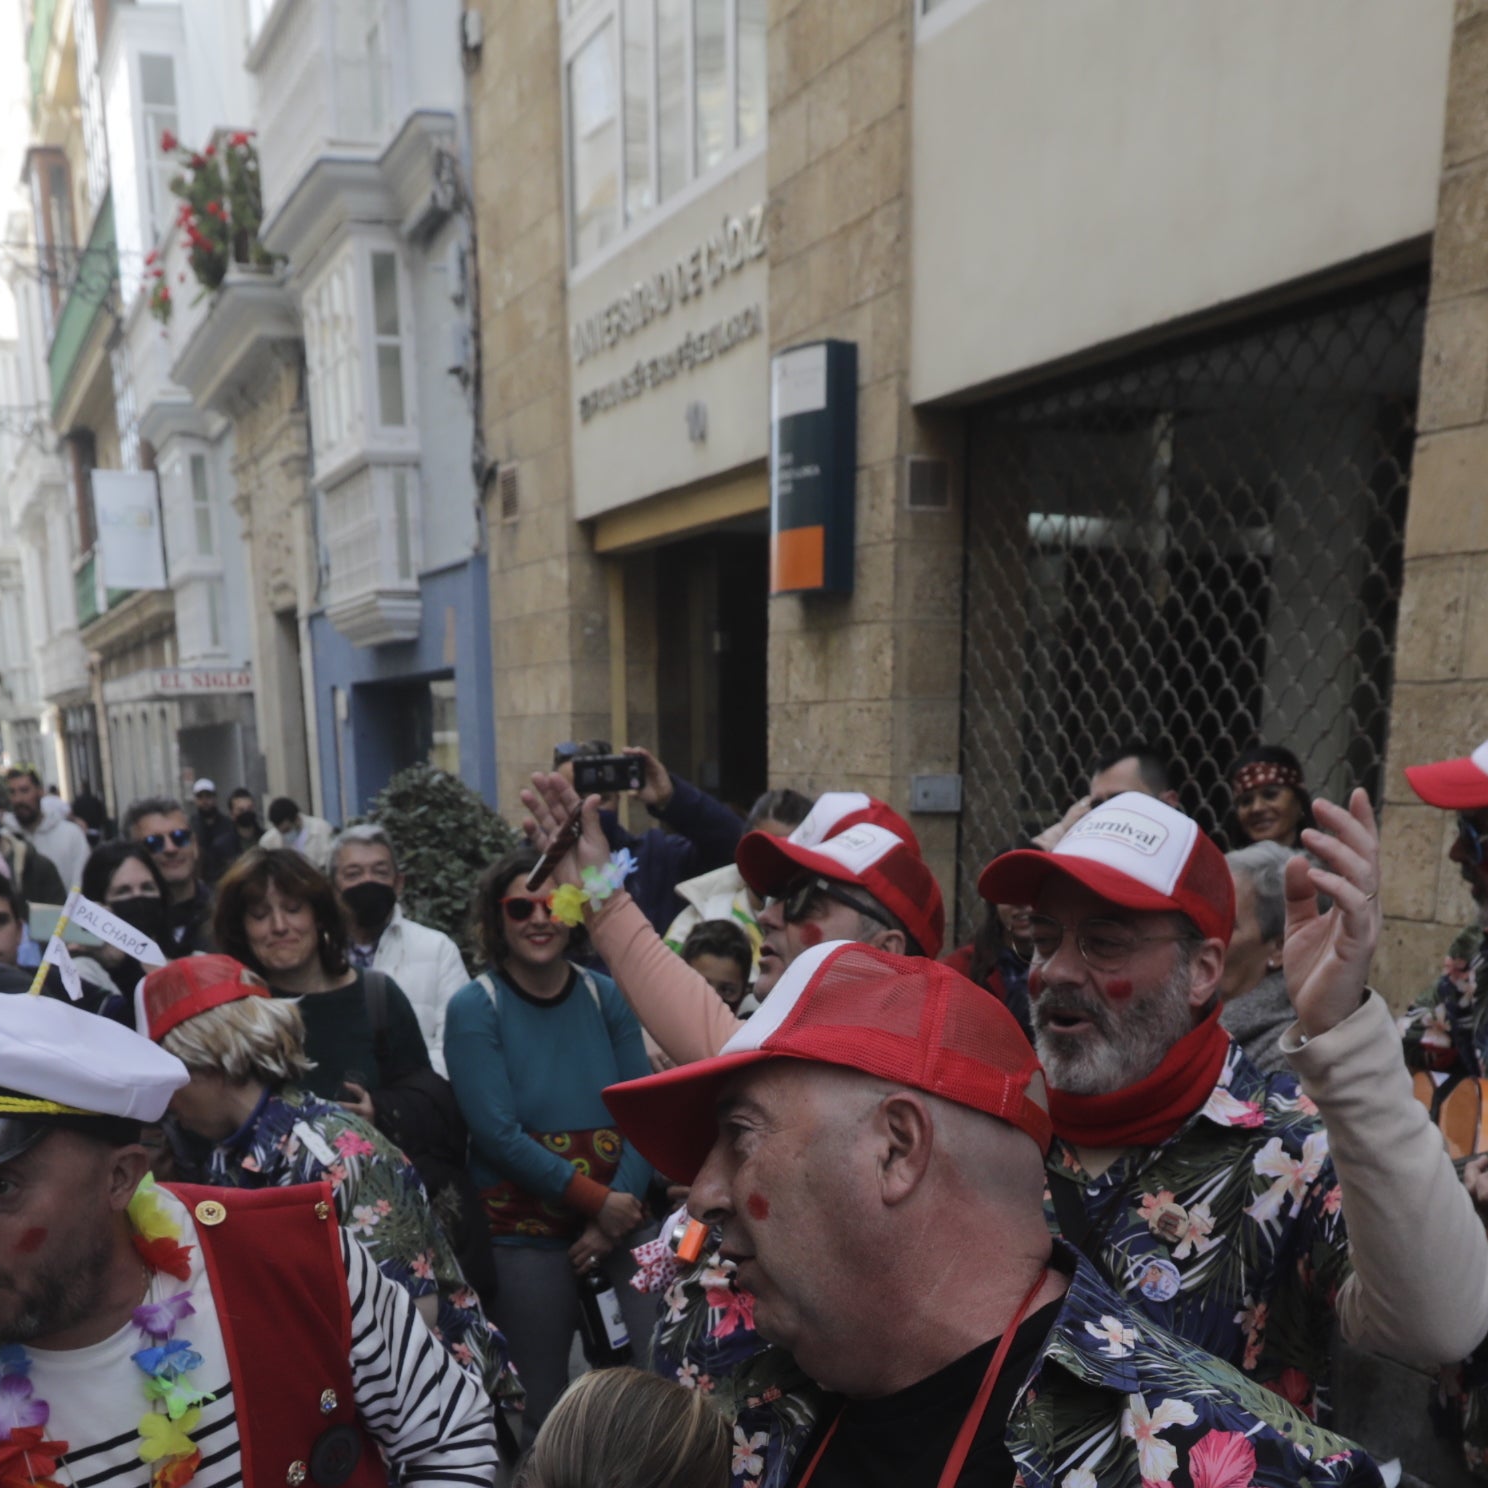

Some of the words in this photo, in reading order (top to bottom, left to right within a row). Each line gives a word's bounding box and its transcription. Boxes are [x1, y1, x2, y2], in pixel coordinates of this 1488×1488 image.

[160, 673, 186, 689] EL
[192, 672, 251, 689] SIGLO
[76, 905, 98, 927] PAL
